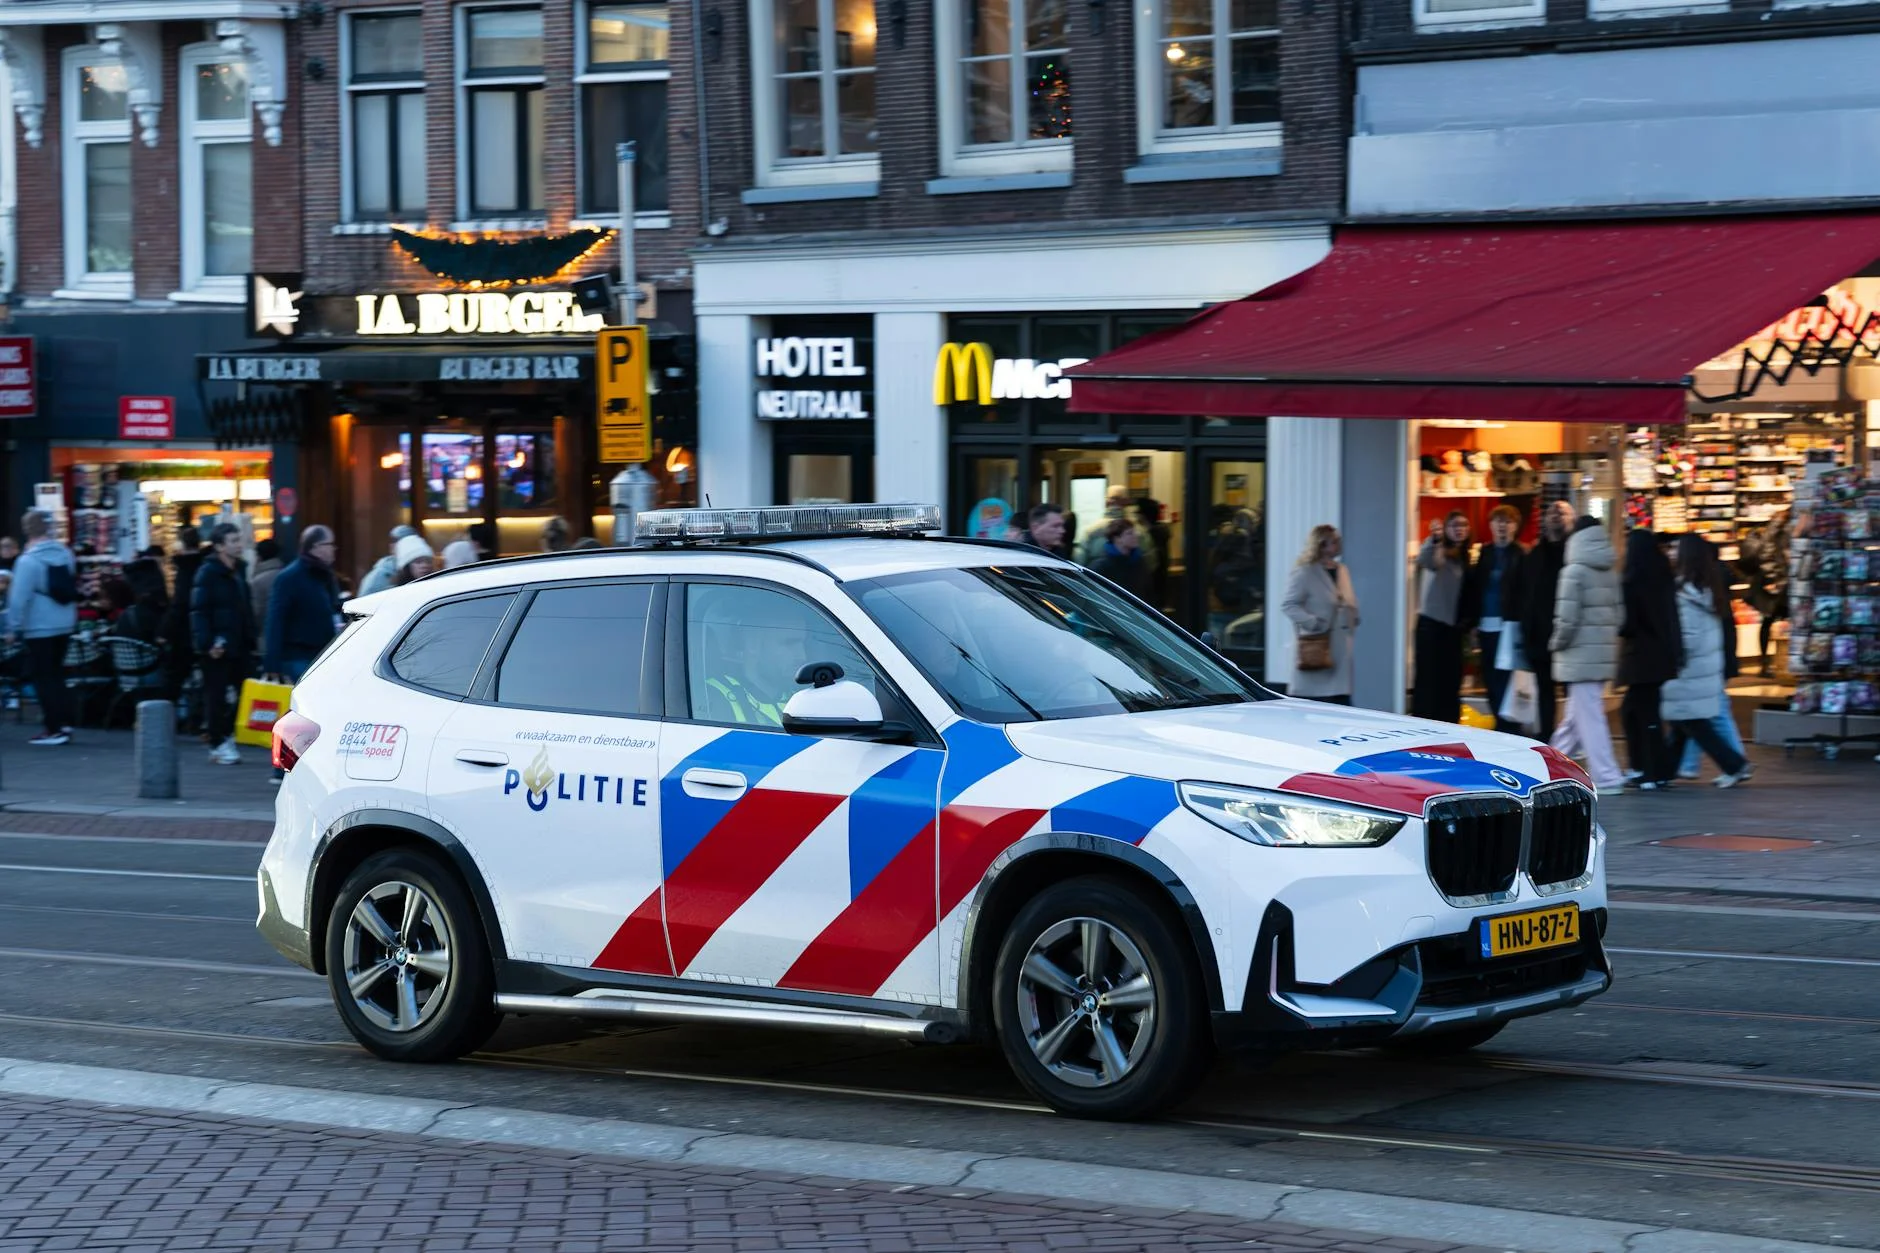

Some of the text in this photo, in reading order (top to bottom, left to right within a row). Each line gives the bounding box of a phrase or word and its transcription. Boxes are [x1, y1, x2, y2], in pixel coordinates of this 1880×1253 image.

[356, 294, 416, 334] LA
[439, 356, 579, 379] BURGER BAR
[609, 336, 632, 382] P
[757, 337, 866, 377] HOTEL
[208, 358, 320, 379] LA BURGER
[757, 390, 868, 418] NEUTRAAL
[344, 722, 372, 733] 0900
[371, 725, 400, 744] 112
[1320, 729, 1449, 746] POLITIE
[340, 734, 367, 746] 8844
[578, 735, 591, 744] en
[365, 746, 394, 758] spoed
[504, 769, 648, 811] POLITIE
[1498, 912, 1574, 950] HNJ-87-Z
